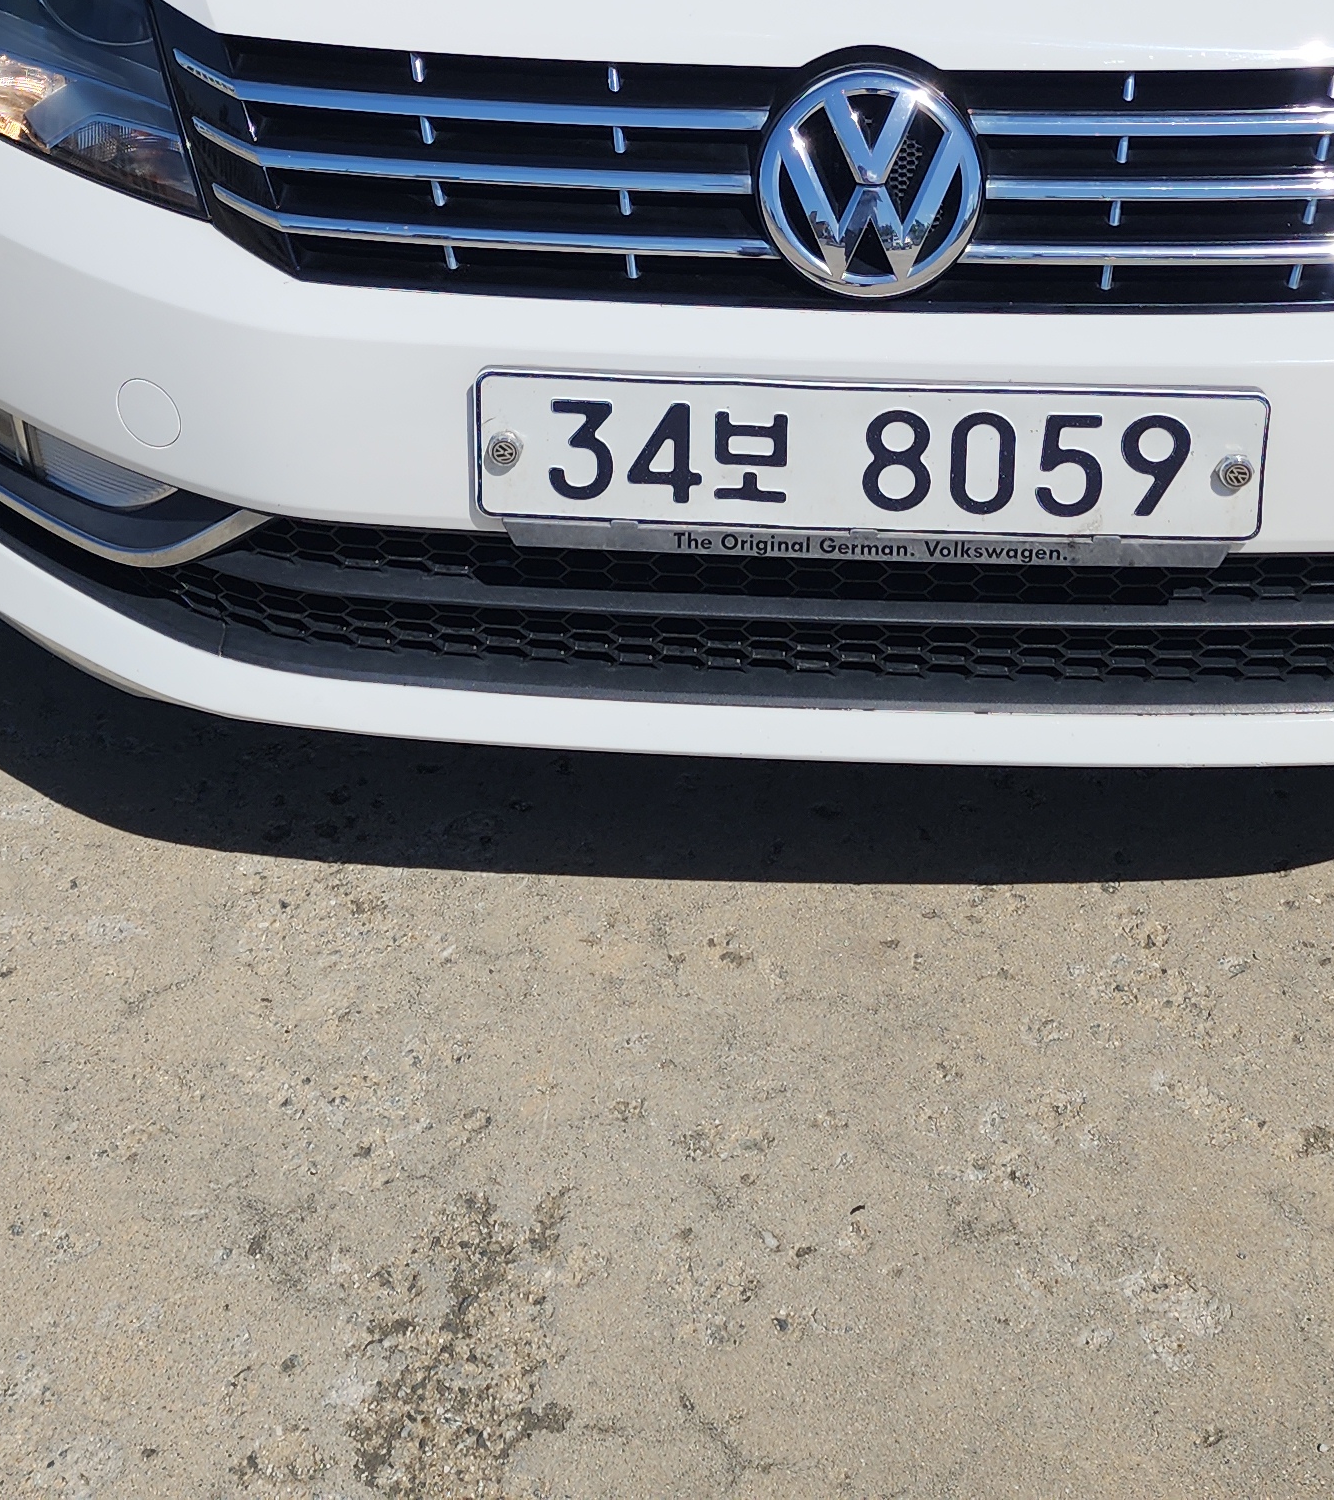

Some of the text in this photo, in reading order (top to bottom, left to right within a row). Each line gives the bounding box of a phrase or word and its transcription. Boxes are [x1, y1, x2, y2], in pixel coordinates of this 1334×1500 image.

[547, 398, 1195, 518] 34보 8059
[673, 531, 1069, 564] The Original German. Volkswagen.
